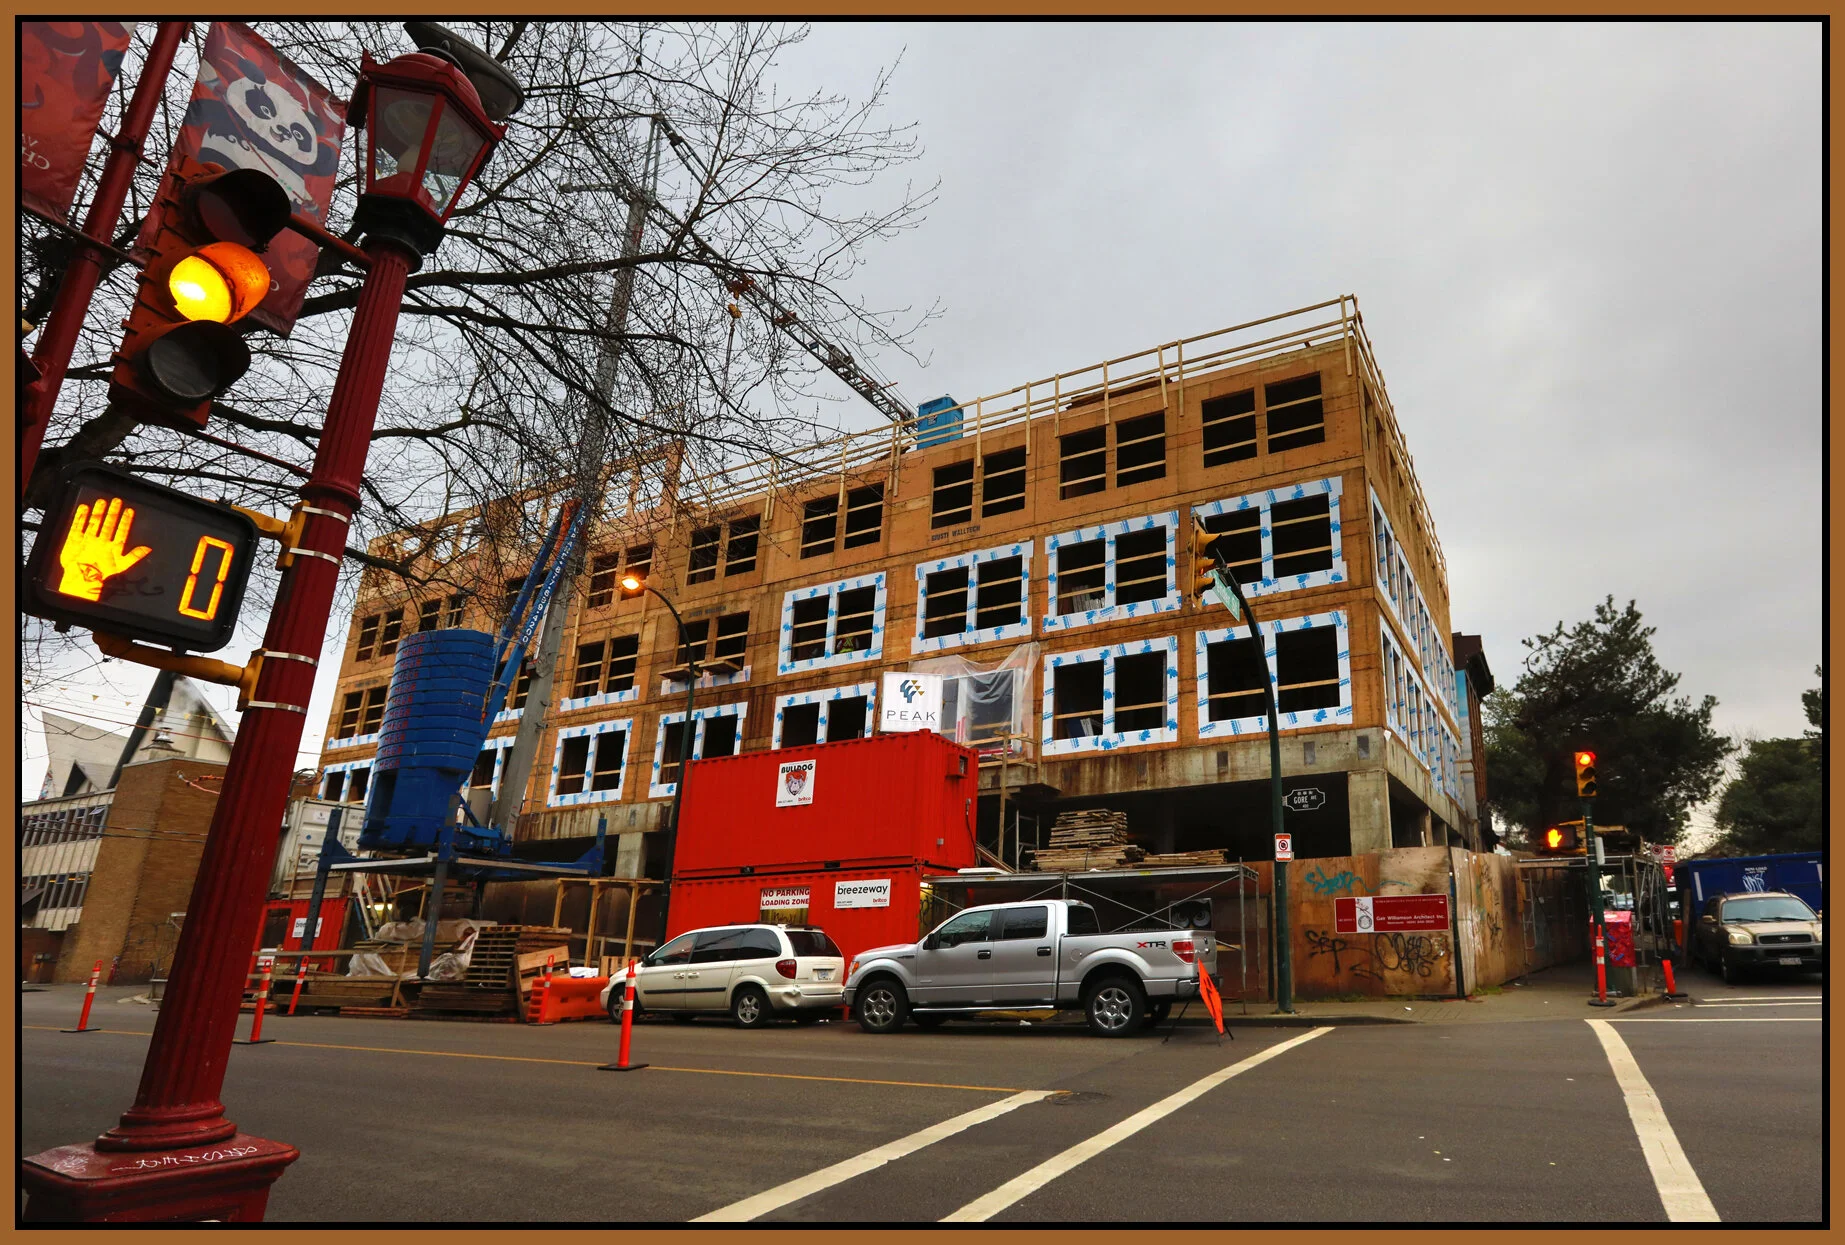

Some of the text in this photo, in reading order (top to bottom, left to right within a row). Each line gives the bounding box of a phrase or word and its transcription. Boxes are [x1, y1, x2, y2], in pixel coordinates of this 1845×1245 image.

[887, 710, 936, 721] PEAK
[781, 763, 813, 773] BULLDOG
[1293, 796, 1308, 804] GORE
[776, 888, 810, 897] PARKING
[837, 885, 888, 895] breezeway
